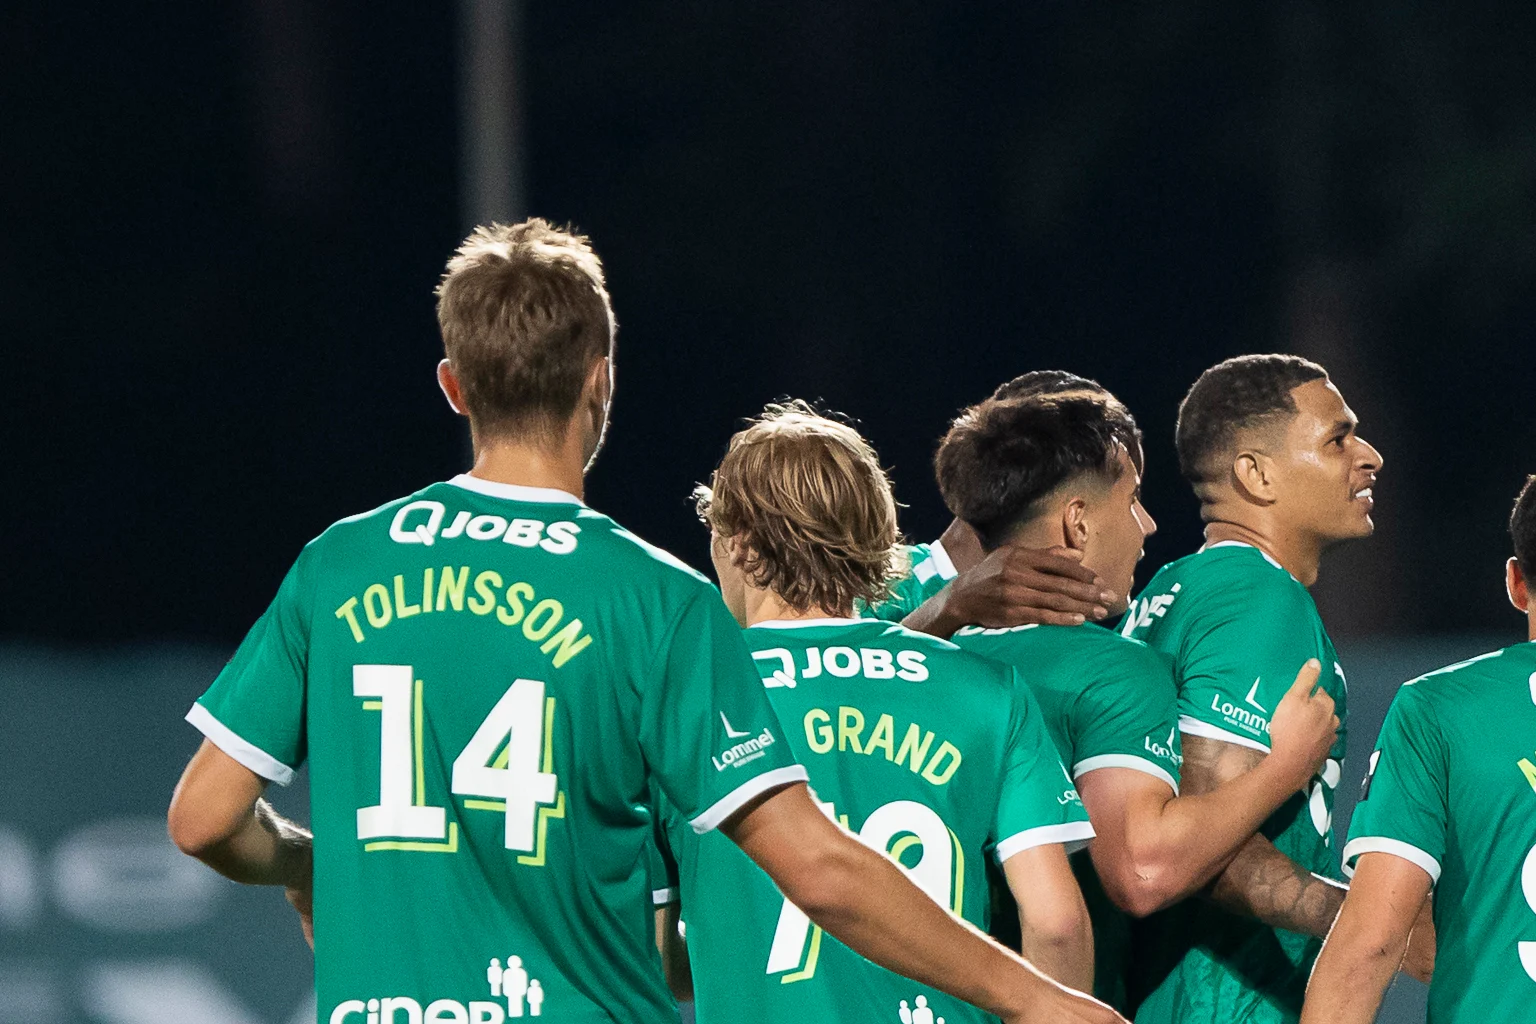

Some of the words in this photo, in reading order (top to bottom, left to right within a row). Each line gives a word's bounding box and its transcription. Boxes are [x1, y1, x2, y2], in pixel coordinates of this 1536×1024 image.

[335, 566, 592, 669] TOLINSSON
[352, 664, 559, 853] 14
[712, 727, 776, 772] Lommel
[803, 706, 961, 785] GRAND
